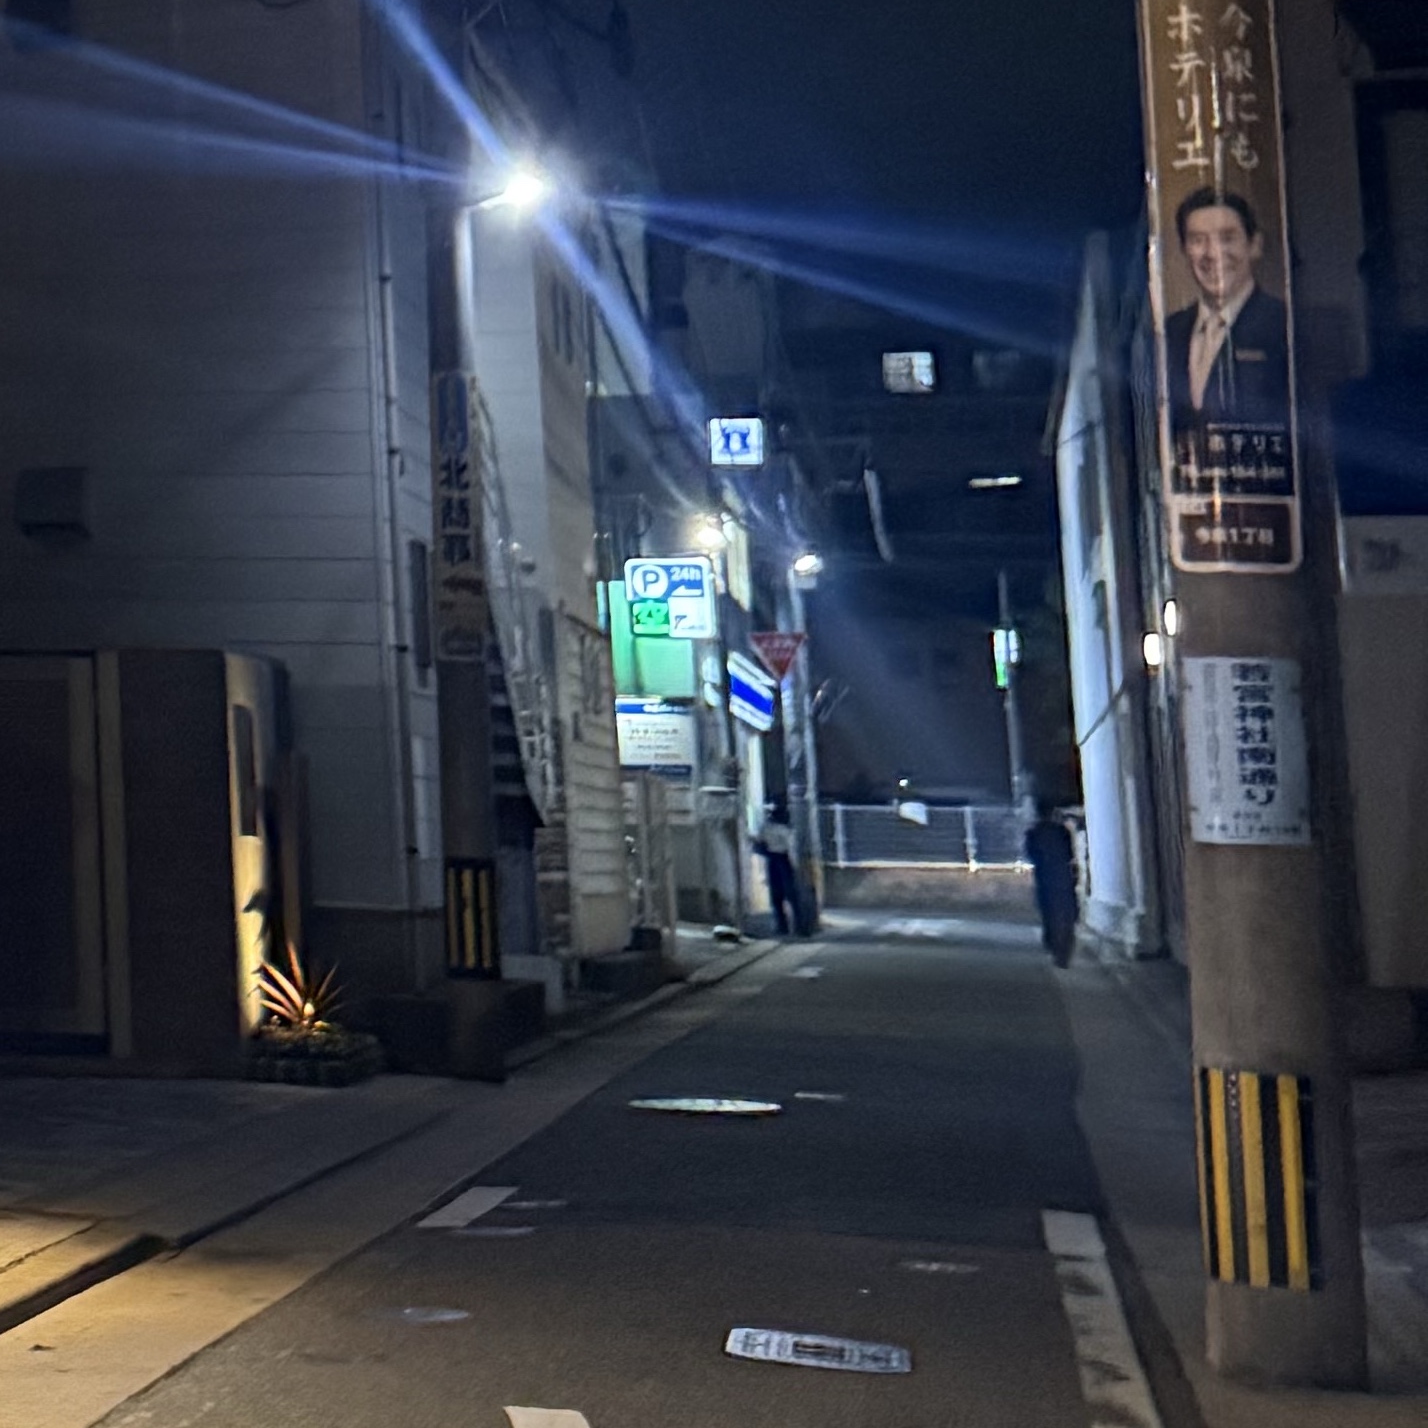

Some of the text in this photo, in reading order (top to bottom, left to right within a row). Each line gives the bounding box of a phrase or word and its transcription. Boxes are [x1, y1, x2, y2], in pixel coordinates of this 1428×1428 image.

[1165, 3, 1212, 171] ホテリエ
[669, 565, 702, 582] 24h
